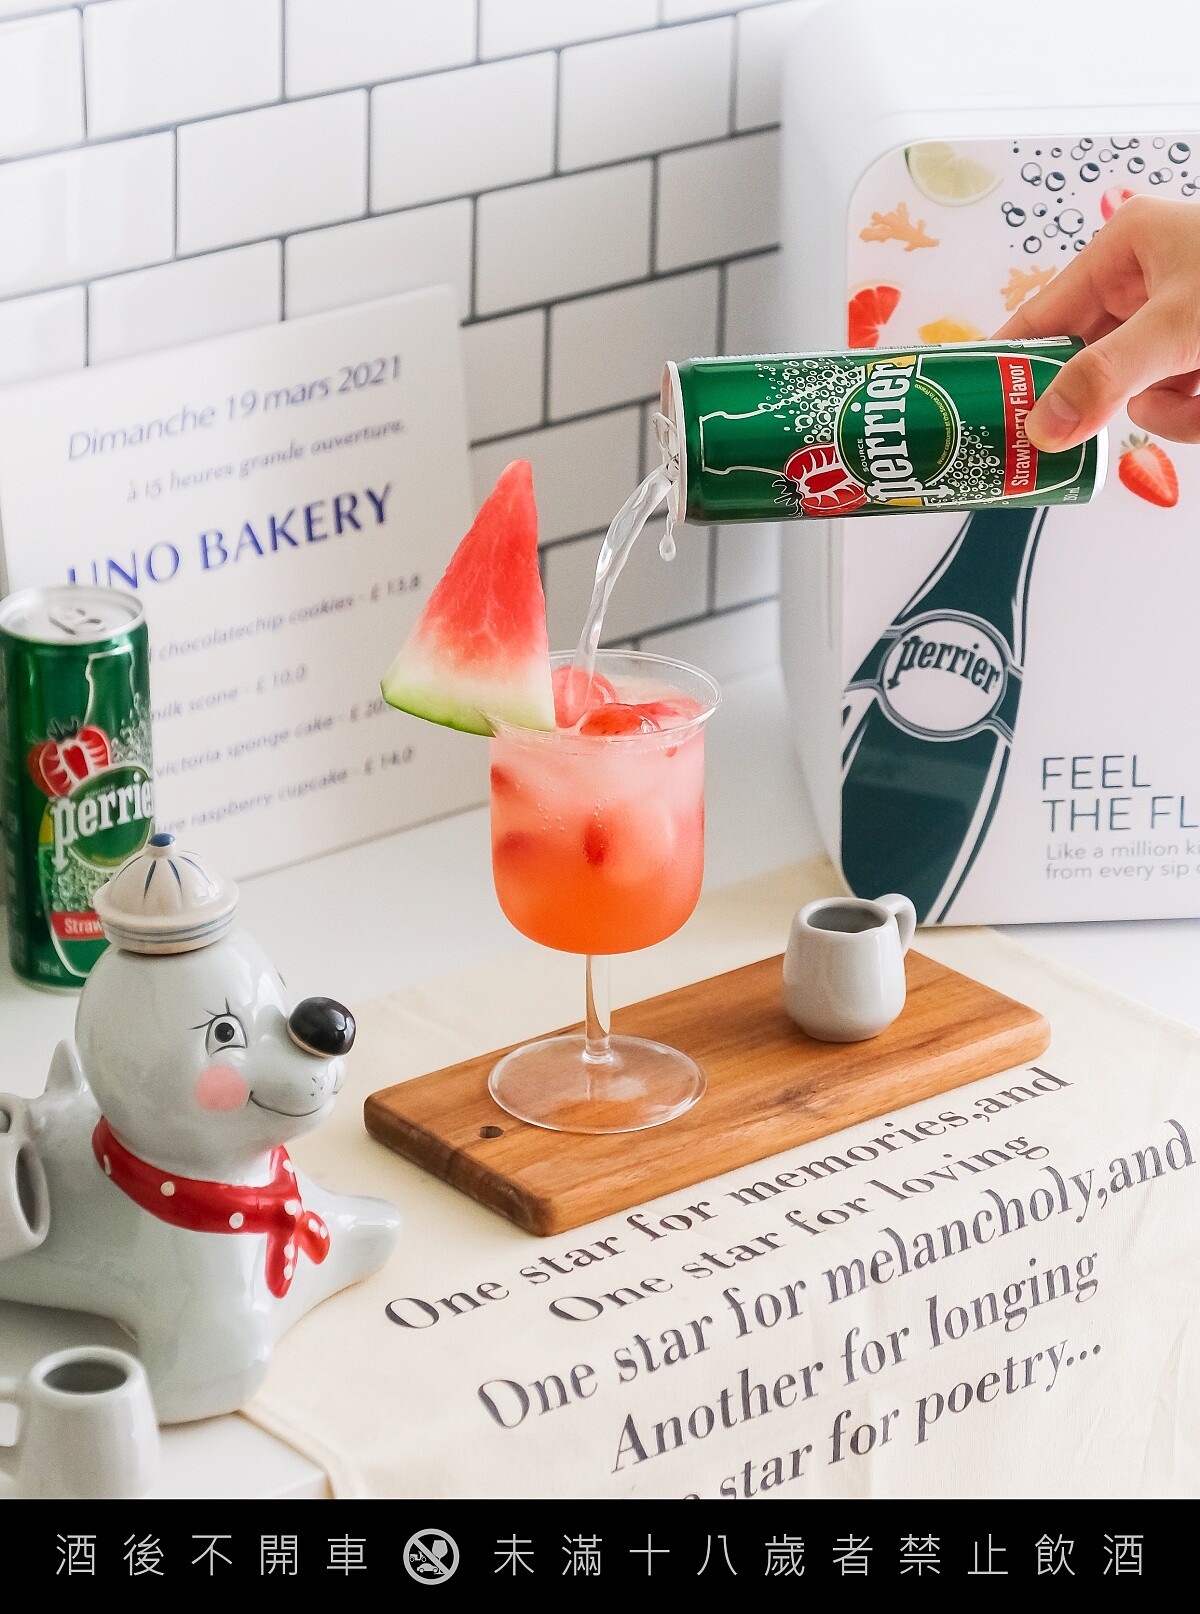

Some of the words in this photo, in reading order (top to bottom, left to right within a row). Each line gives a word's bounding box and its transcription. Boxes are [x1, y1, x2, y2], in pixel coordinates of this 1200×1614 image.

[68, 405, 216, 461] Dimanche
[227, 391, 258, 421] 19
[262, 375, 330, 414] mars
[337, 354, 401, 395] 2021
[1009, 364, 1028, 405] Flavor
[145, 481, 162, 500] 15
[169, 463, 232, 491] heures
[239, 439, 303, 478] grande
[310, 418, 406, 456] ouverture.
[850, 362, 956, 505] perrier
[857, 438, 869, 472] SOURCE
[1011, 408, 1030, 486] Strawberry
[67, 541, 181, 589] UNO
[199, 482, 394, 571] BAKERY
[159, 614, 283, 662] chocolatechip
[289, 596, 353, 625] cookies
[886, 634, 1001, 695] perrier
[188, 688, 239, 712] scone
[156, 749, 221, 777] victoria
[226, 730, 289, 758] sponge
[294, 714, 333, 738] cake
[1042, 754, 1152, 791] FEEL
[191, 793, 273, 826] raspberry
[277, 768, 347, 800] cupcake
[1042, 797, 1133, 833] THE
[1150, 795, 1200, 830] FL
[1046, 842, 1087, 861] Like
[1093, 846, 1104, 859] a
[1111, 839, 1179, 858] million
[1046, 863, 1093, 880] from
[1099, 864, 1155, 882] every
[1160, 861, 1190, 879] sip
[384, 1281, 509, 1329] One
[519, 1236, 626, 1285] star
[626, 1201, 718, 1242] for
[725, 1066, 1074, 1207] memories,and
[548, 1277, 673, 1322] One
[682, 1232, 786, 1280] star
[785, 1197, 875, 1237] for
[864, 1134, 1050, 1203] loving
[477, 1363, 598, 1430] One
[614, 1315, 713, 1385] star
[722, 1280, 807, 1339] for
[822, 1119, 1196, 1305] melancholy,and
[611, 1361, 824, 1474] Another
[840, 1325, 910, 1387] for
[926, 1252, 1100, 1351] longing
[720, 1444, 813, 1499] star
[828, 1408, 900, 1466] for
[914, 1339, 1101, 1445] poetry...
